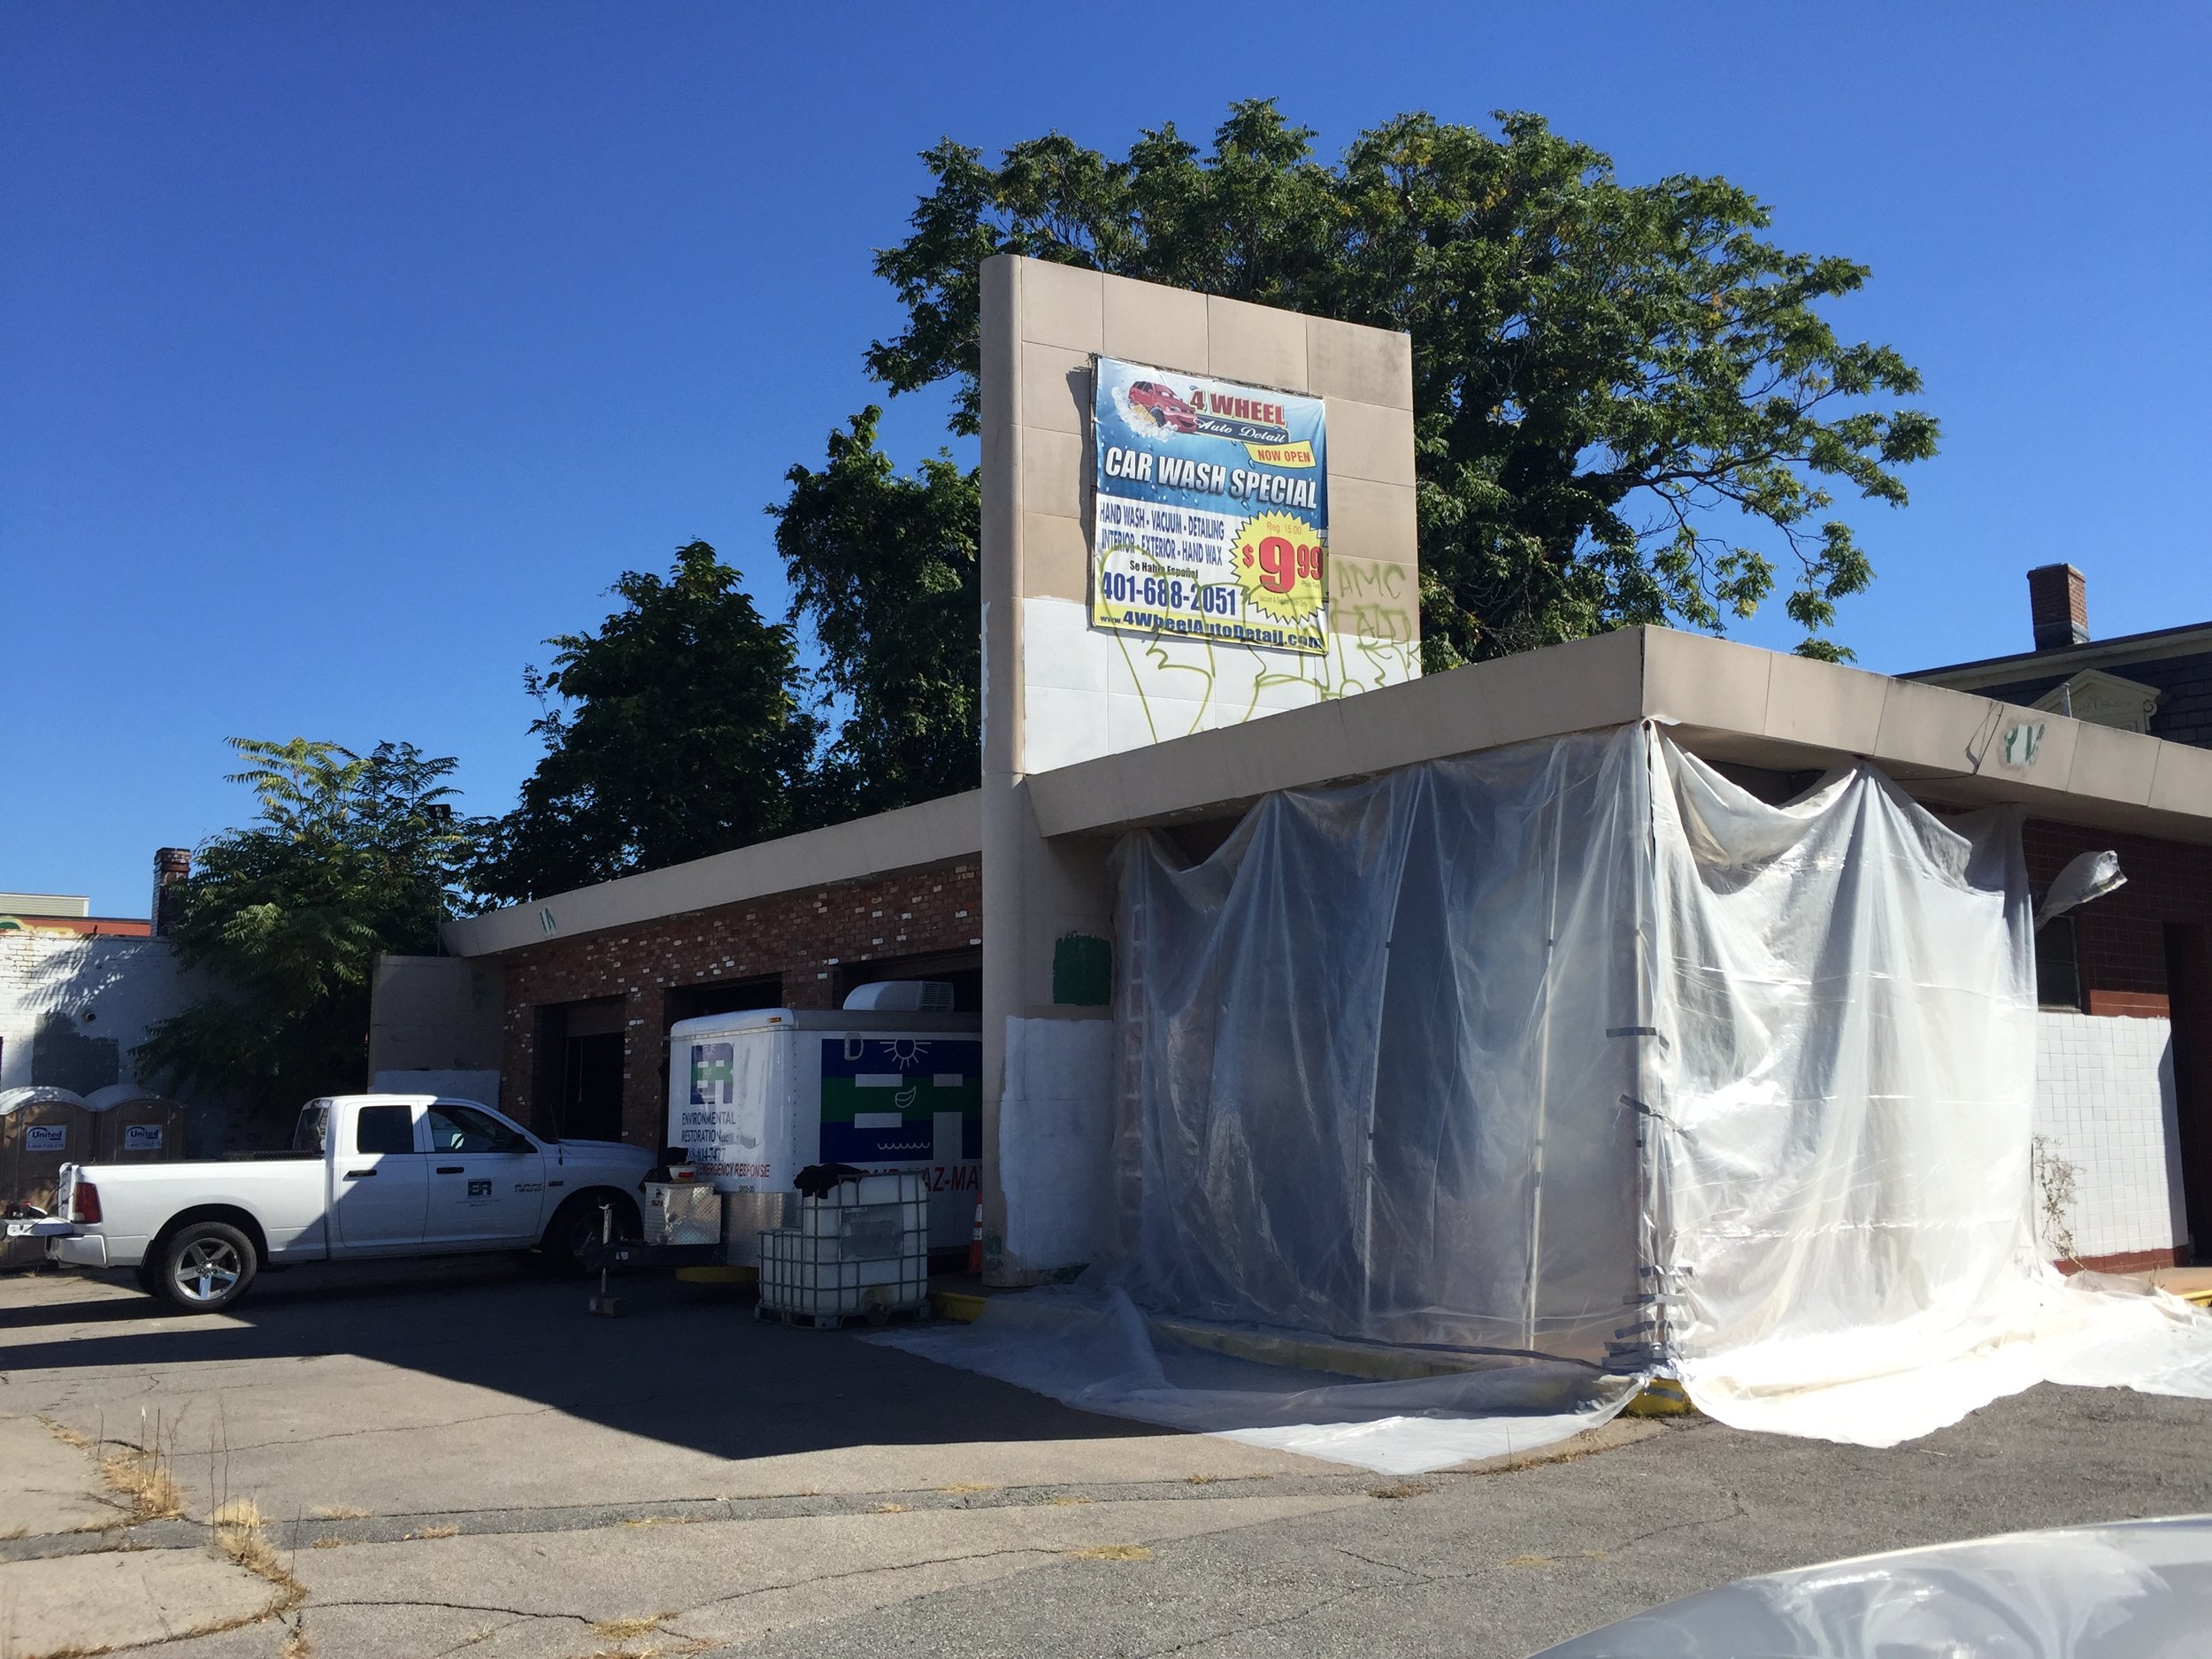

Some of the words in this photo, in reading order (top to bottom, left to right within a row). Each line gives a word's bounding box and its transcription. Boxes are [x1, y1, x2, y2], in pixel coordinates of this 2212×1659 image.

[1189, 389, 1204, 411] 4
[1210, 392, 1286, 426] WHEEL
[1194, 418, 1233, 434] Auto
[1239, 426, 1286, 443] Detail
[1257, 449, 1280, 461] NOW
[1284, 450, 1311, 463] OPEN
[1105, 447, 1153, 481] CAR
[1157, 456, 1227, 494] WASH
[1230, 469, 1317, 509] SPECIAL
[1100, 502, 1121, 525] HAND
[1124, 505, 1145, 528] WASH
[1151, 510, 1182, 534] VACUUM
[1188, 515, 1225, 541] DETAILING
[1266, 521, 1279, 534] Reg
[1102, 528, 1134, 554] INTERIOR
[1141, 534, 1176, 560] EXTERIOR
[1182, 541, 1203, 563] HAND
[1206, 546, 1223, 566] WAX
[1130, 560, 1141, 572] Se
[1102, 572, 1236, 616] 401-688-2051
[1101, 611, 1322, 648] www.4WheelAutoDetail.com
[681, 1110, 736, 1125] ENVIRONMENTAL
[32, 1130, 63, 1139] United
[130, 1129, 159, 1139] United
[681, 1129, 721, 1142] RESTORATION
[699, 1163, 734, 1177] EMERGENCY
[734, 1164, 771, 1179] RESPONSE
